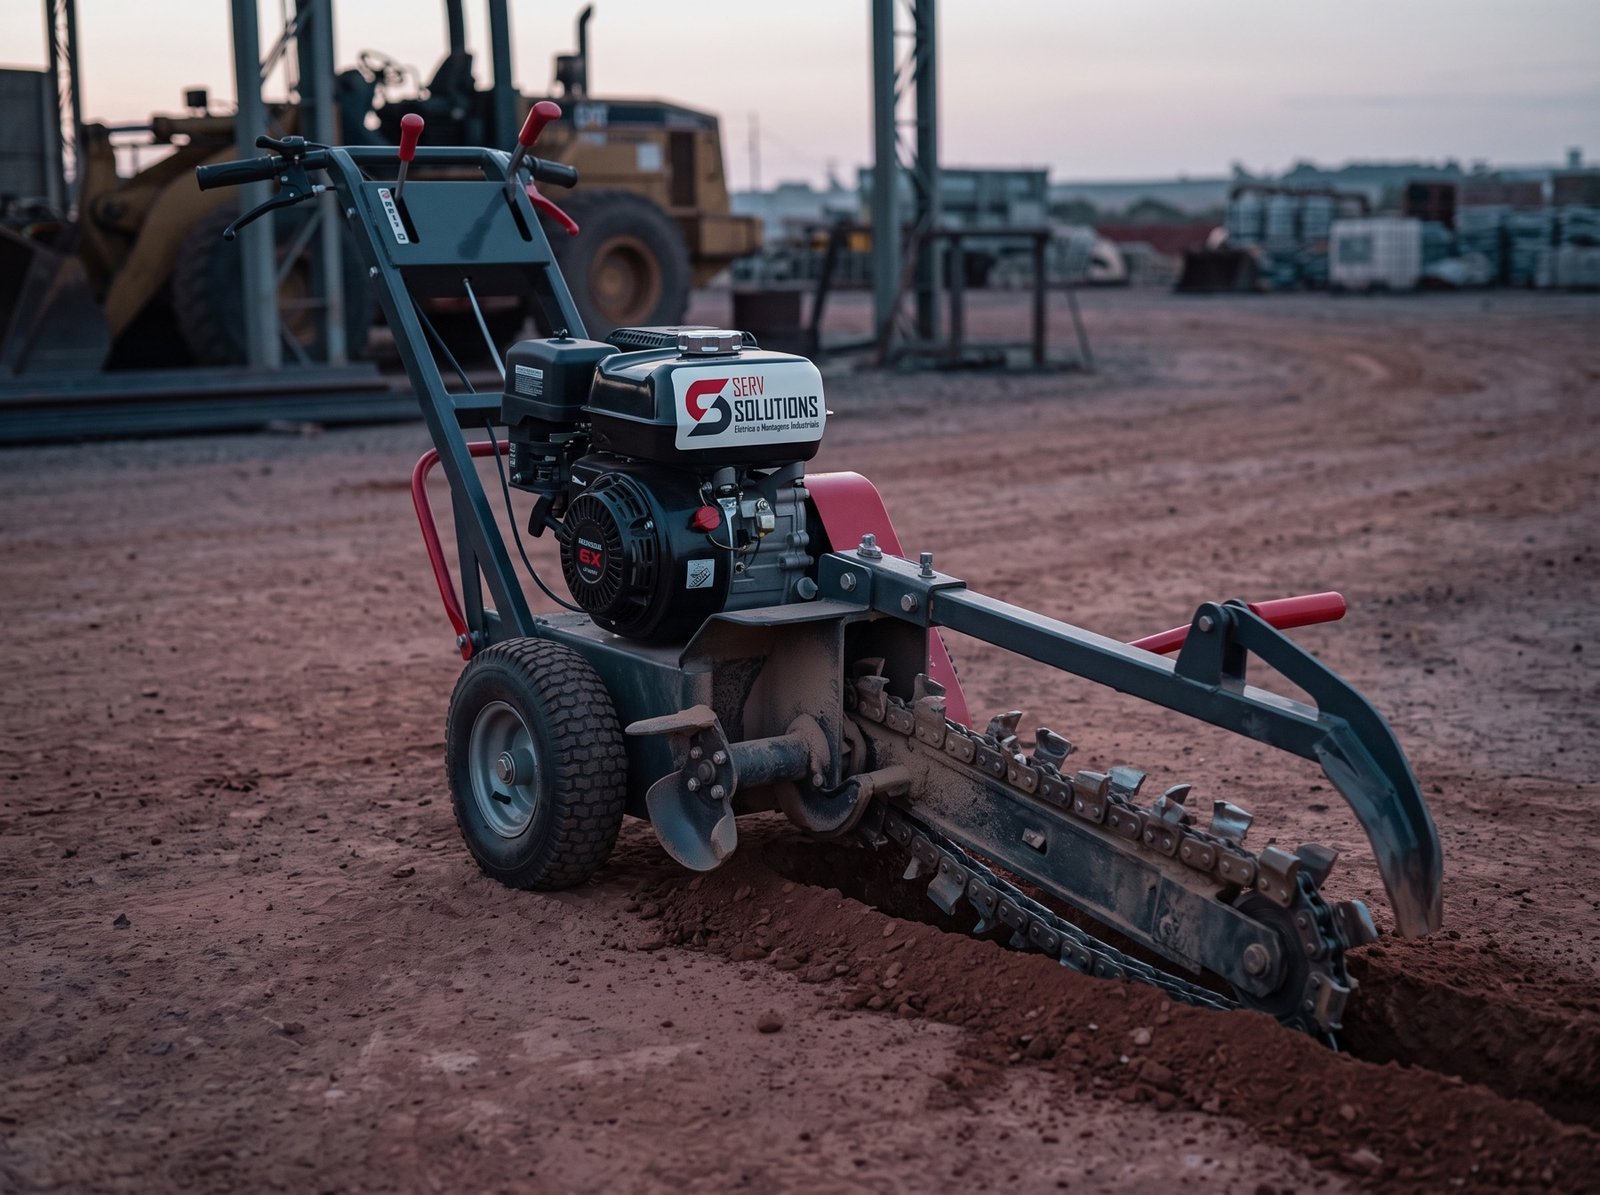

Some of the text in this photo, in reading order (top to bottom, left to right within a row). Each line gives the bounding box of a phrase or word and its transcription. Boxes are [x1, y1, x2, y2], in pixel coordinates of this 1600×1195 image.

[732, 375, 765, 398] SERV
[734, 395, 819, 423] SOLUTIONS
[761, 422, 790, 433] Montagens
[790, 420, 820, 431] Industriais
